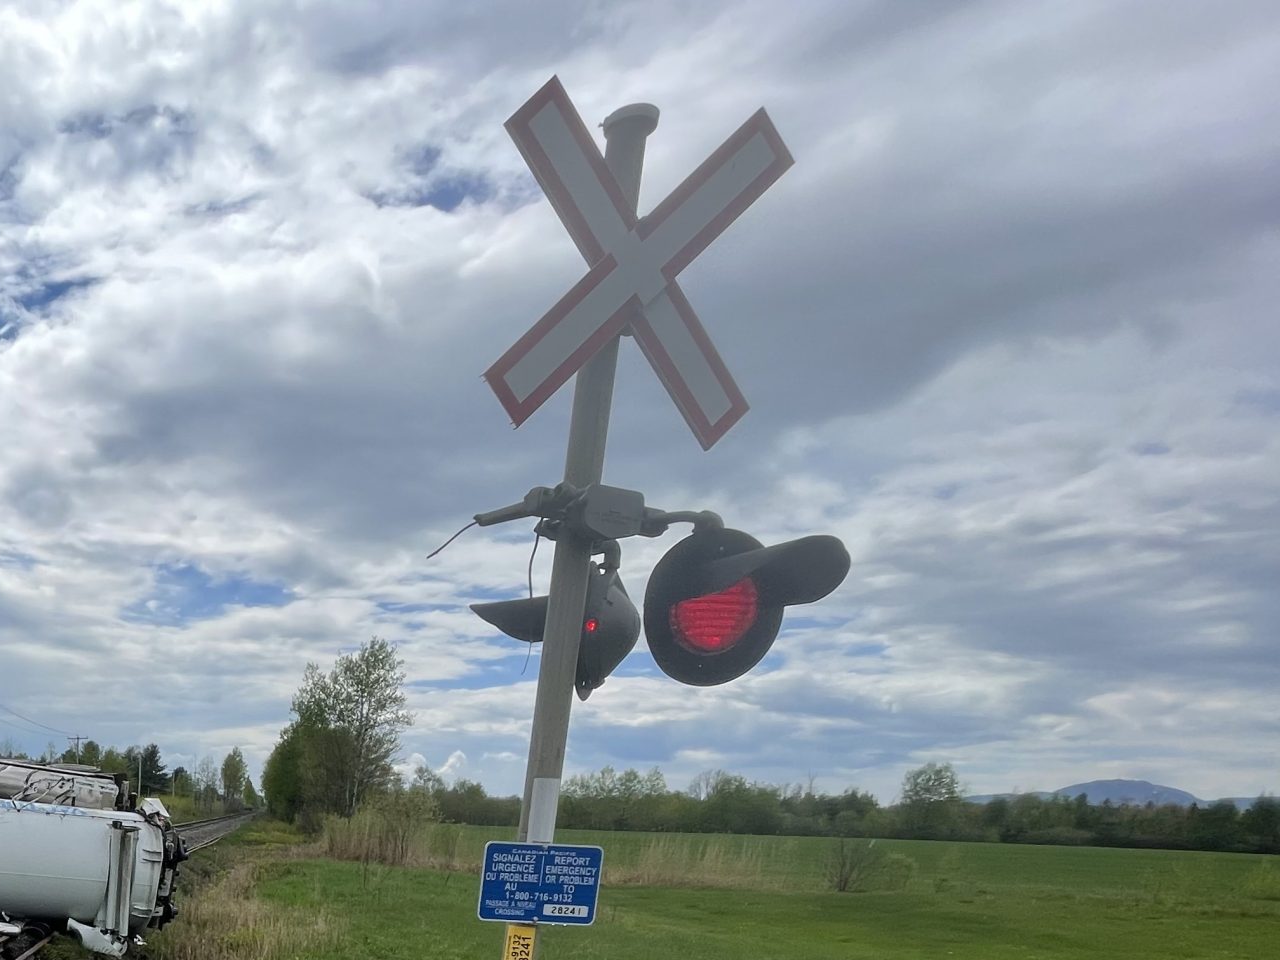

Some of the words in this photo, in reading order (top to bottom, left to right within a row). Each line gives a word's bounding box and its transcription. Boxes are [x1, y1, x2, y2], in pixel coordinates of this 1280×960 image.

[493, 853, 536, 863] SIGNALEZ
[554, 856, 590, 866] REPORT
[492, 863, 535, 873] URGENCE
[545, 865, 597, 876] EMERGENCY
[485, 872, 497, 880] OU
[545, 875, 557, 884] OR
[559, 876, 595, 886] PROBLEM
[504, 882, 517, 890] AU
[563, 885, 575, 894] TO
[505, 891, 573, 902] 1-800-716-9132
[551, 906, 581, 915] 28241
